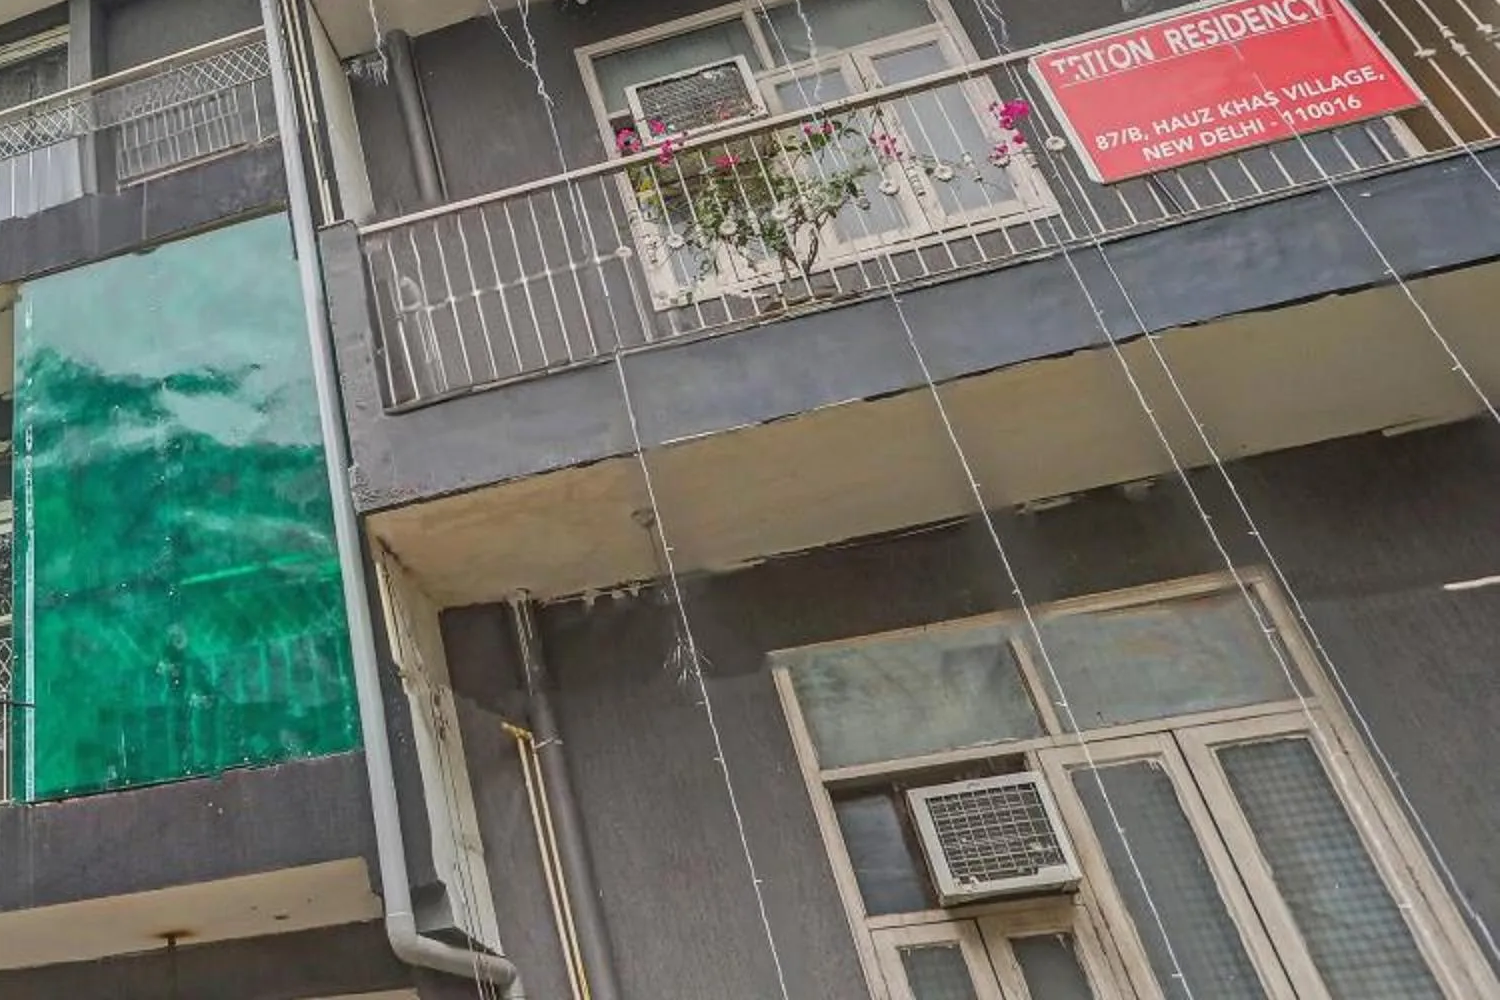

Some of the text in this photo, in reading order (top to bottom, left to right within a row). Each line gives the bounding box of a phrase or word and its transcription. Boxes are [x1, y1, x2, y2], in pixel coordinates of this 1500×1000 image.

[1094, 64, 1385, 151] 87/B, HAUZ KHAS VILLAGE,
[1142, 137, 1195, 163] NEW
[1199, 118, 1266, 147] DELHI
[1282, 93, 1363, 126] 110016
